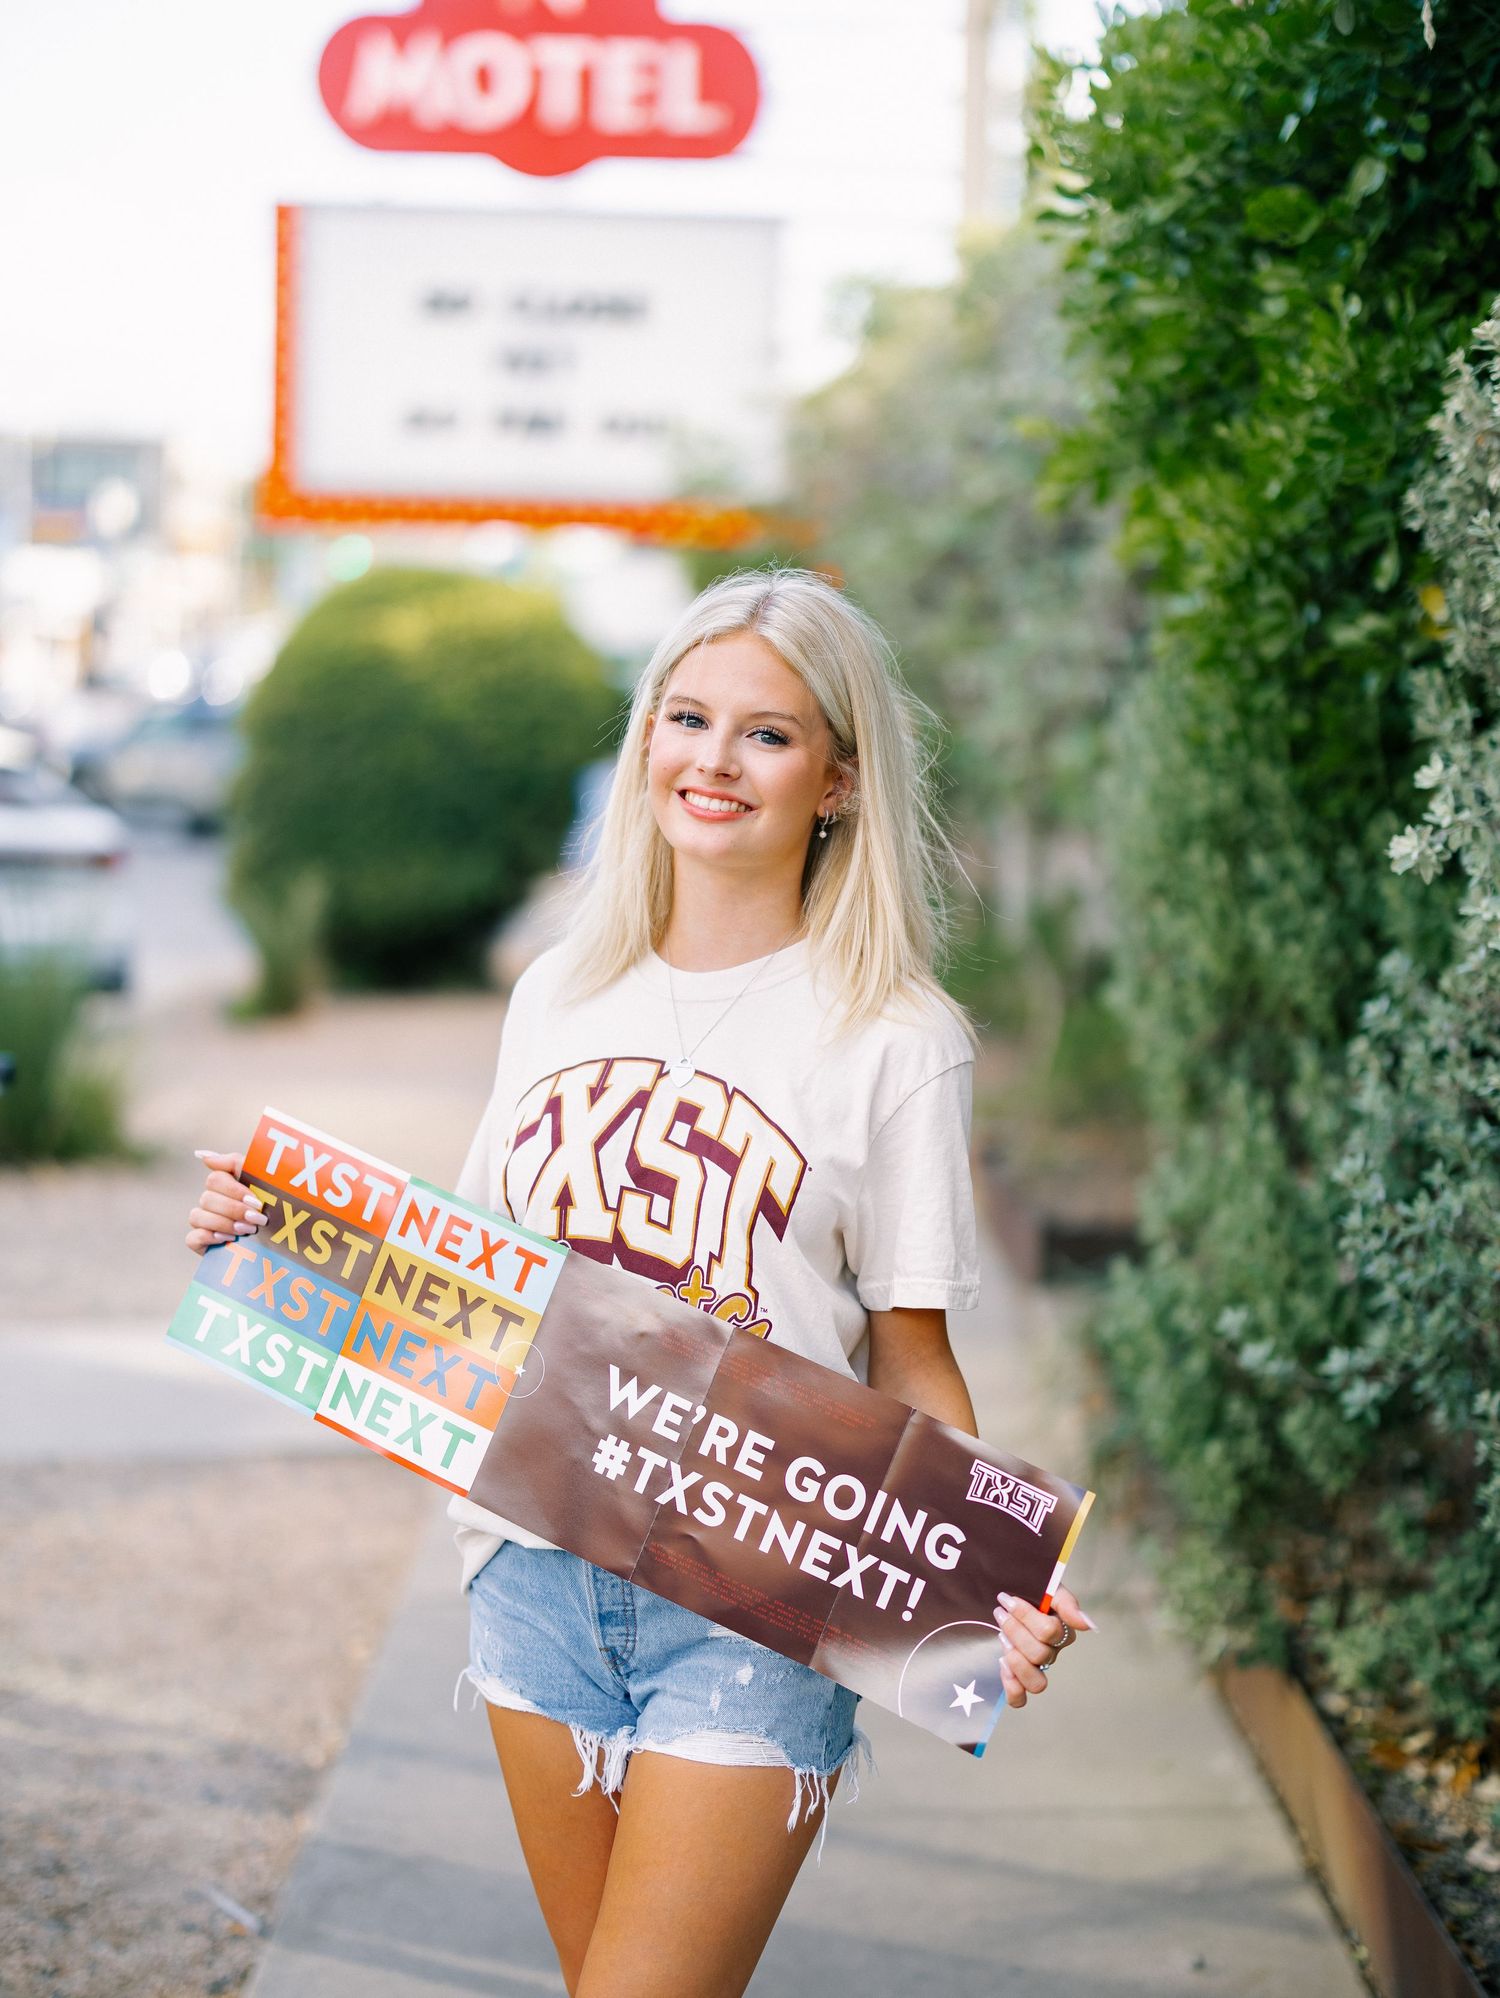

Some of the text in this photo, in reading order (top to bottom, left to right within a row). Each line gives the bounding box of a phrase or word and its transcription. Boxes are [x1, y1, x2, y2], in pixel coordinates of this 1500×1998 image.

[342, 26, 733, 138] MOTEL
[264, 1127, 548, 1293] TXST NEXT
[194, 1295, 476, 1469] TXST NEXT
[222, 1241, 499, 1411] TXST NEXT
[374, 1254, 525, 1351] NEXT
[591, 1433, 926, 1622] #TXSTNEXT!
[608, 1363, 776, 1481] WE’RE
[784, 1455, 967, 1571] GOING
[966, 1459, 1058, 1534] TXST
